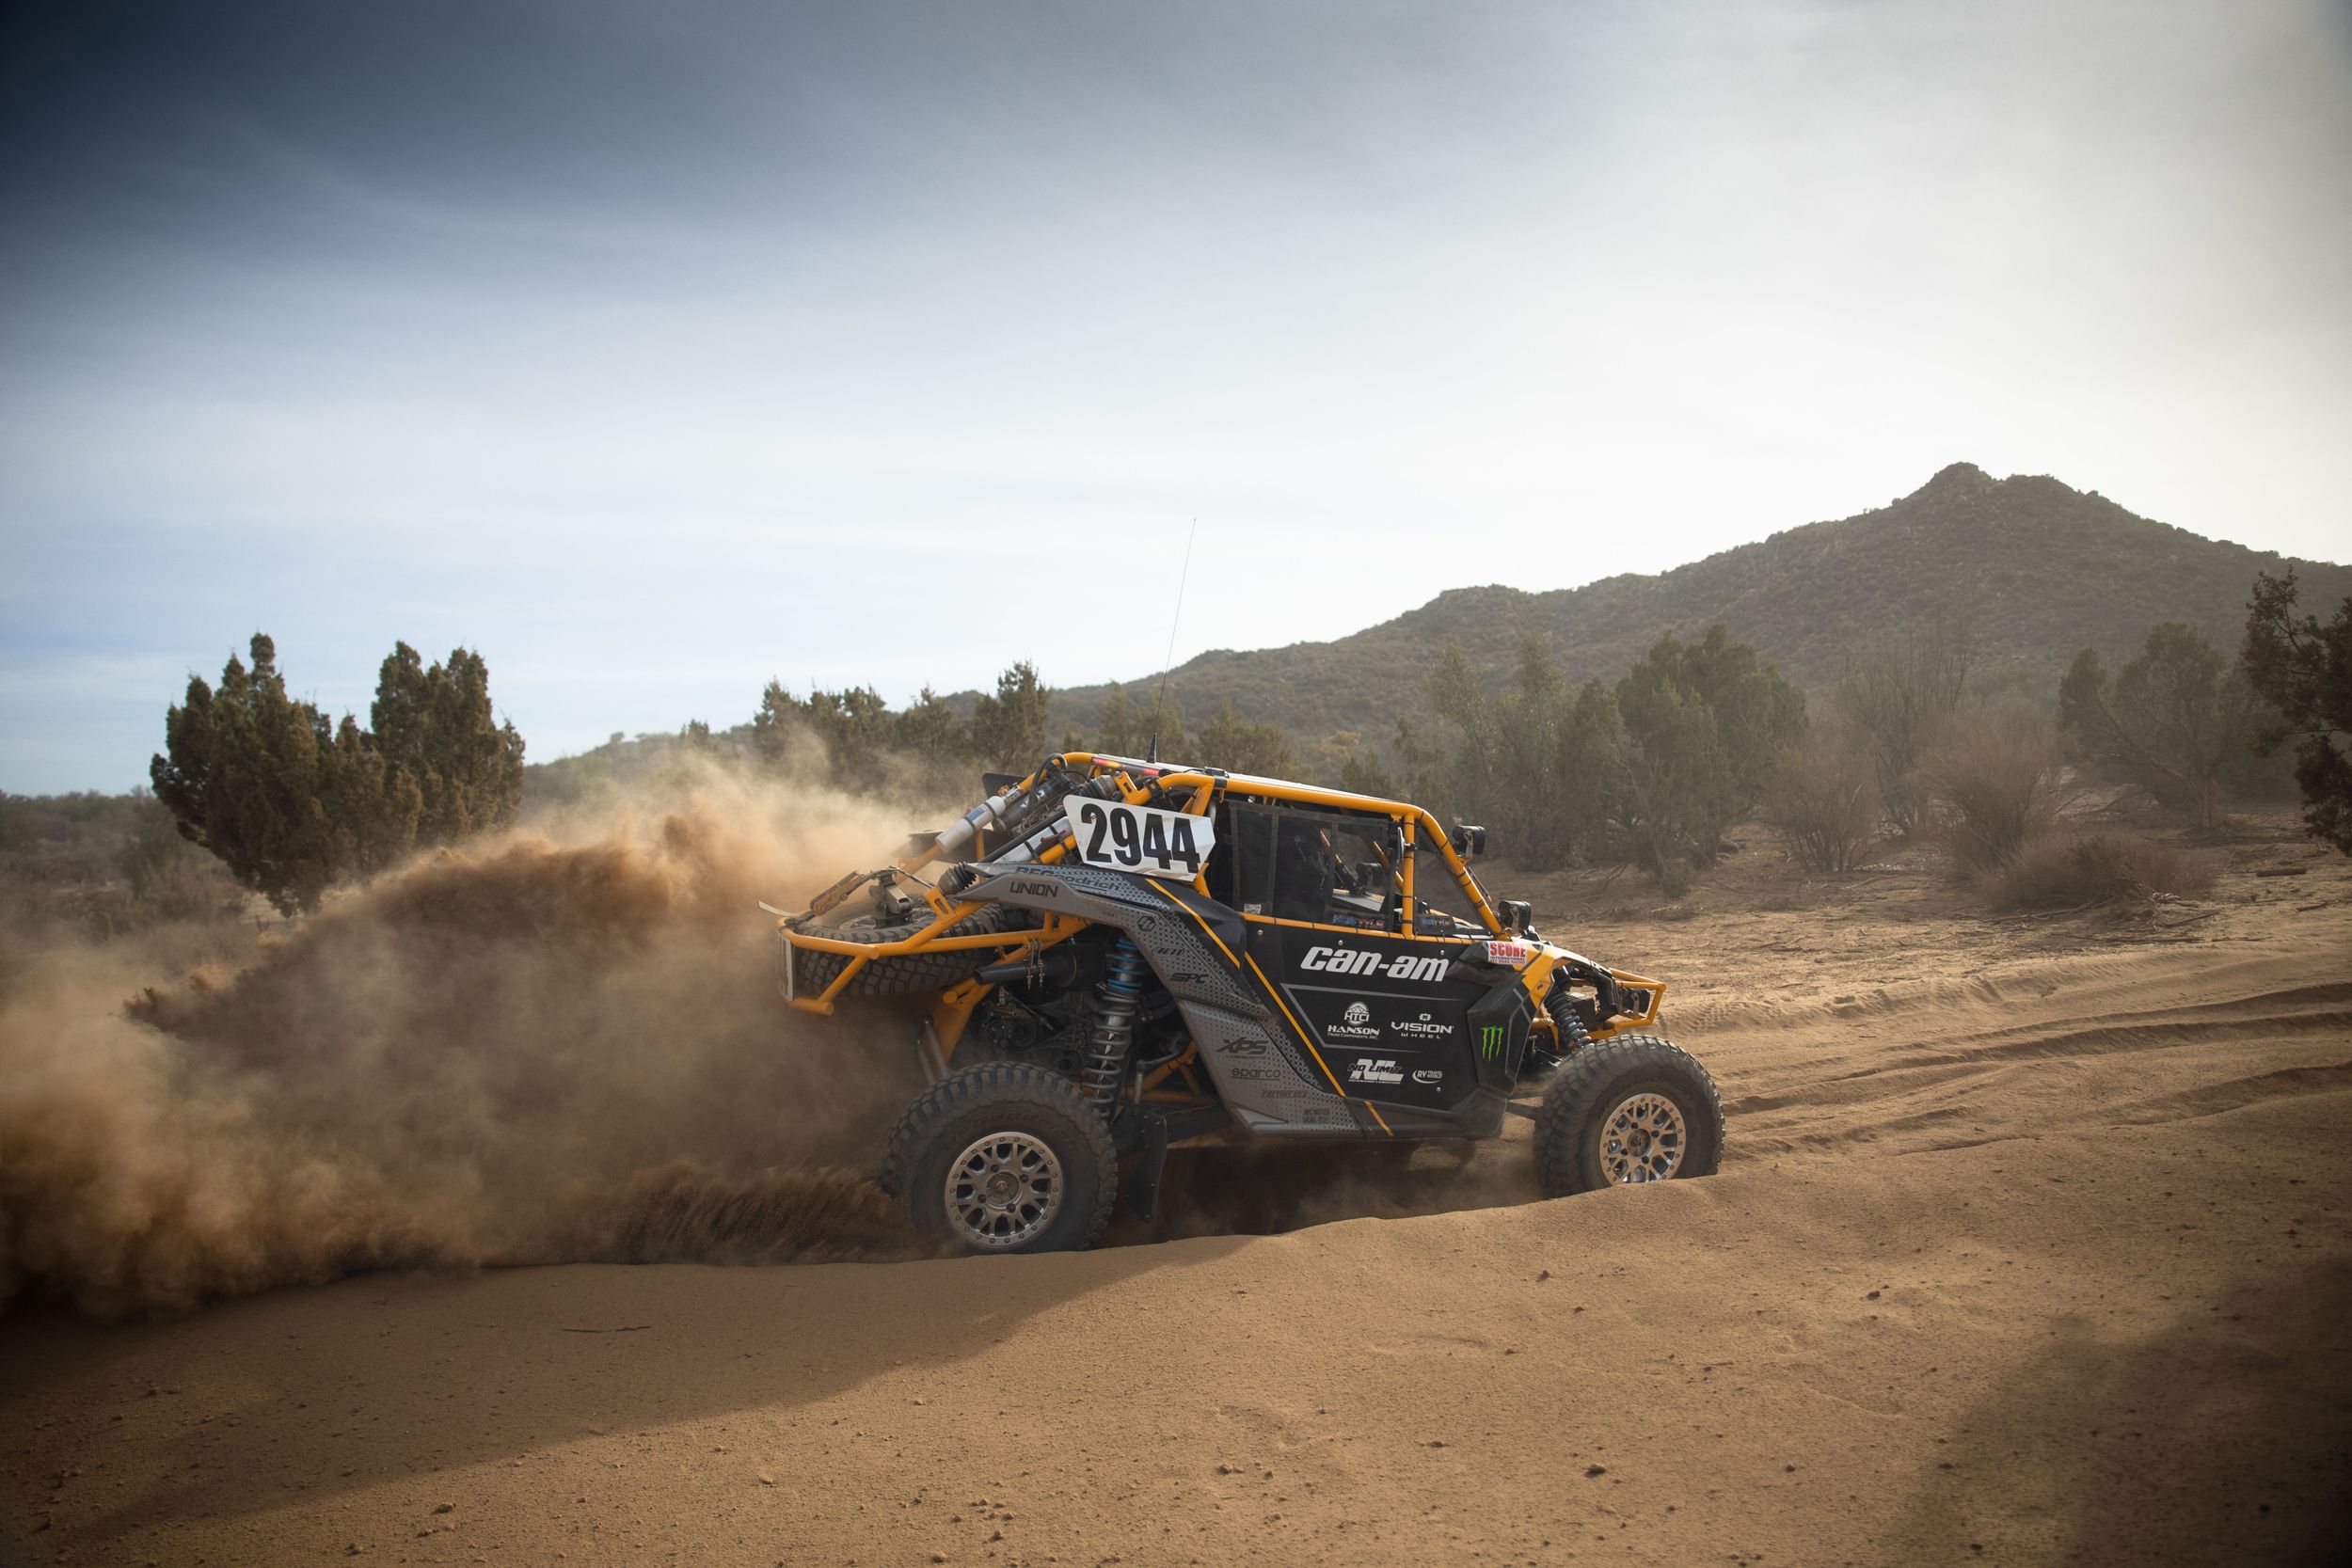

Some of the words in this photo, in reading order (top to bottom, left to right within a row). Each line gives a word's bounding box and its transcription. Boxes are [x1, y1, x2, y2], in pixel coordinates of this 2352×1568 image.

[1081, 803, 1200, 873] 2944
[1009, 881, 1058, 897] UNION
[1490, 942, 1526, 958] SCORE
[1169, 973, 1210, 984] SPC
[1344, 1012, 1370, 1022] HTCI
[1327, 1025, 1380, 1036] HANSON
[1391, 1022, 1452, 1034] VISION
[1216, 1037, 1269, 1055] XPS
[1232, 1068, 1280, 1078] sparco
[1347, 1063, 1366, 1072] NO
[1368, 1066, 1402, 1074] LIMIT
